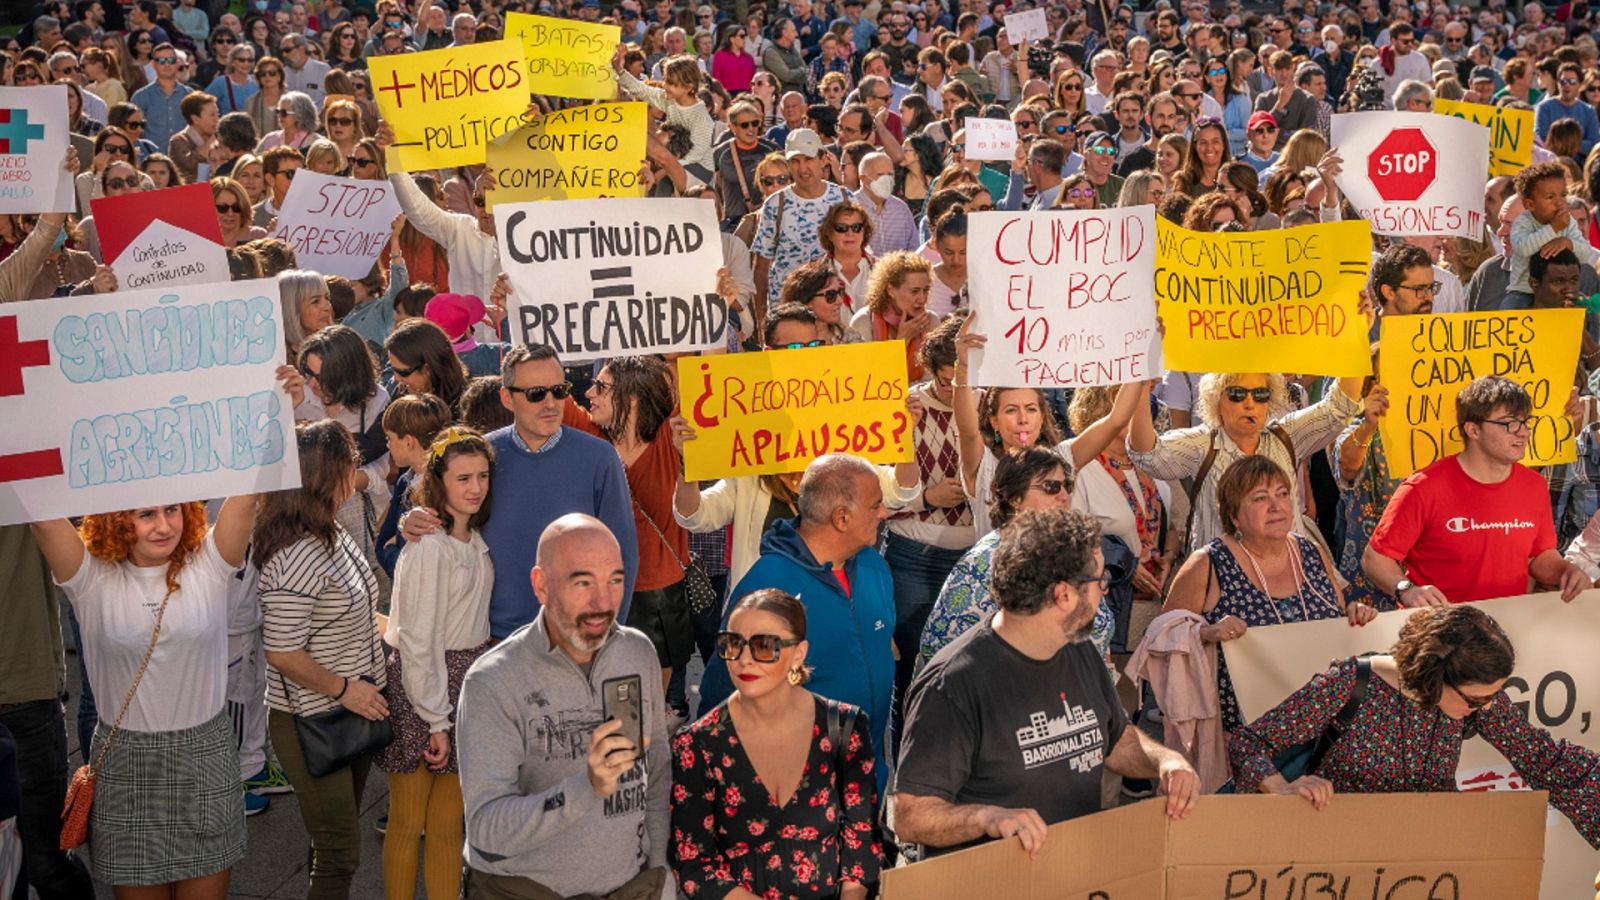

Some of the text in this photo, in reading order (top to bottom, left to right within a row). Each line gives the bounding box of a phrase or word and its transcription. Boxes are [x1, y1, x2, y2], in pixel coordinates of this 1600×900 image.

[420, 58, 522, 103] MÉDICOS
[524, 56, 611, 83] ORBATAS
[527, 133, 619, 151] CONTIGO
[498, 165, 636, 188] COMPAÑERO
[1377, 150, 1430, 176] STOP
[307, 182, 386, 219] STOP
[505, 210, 704, 264] CONTINUIDAD
[994, 215, 1144, 266] CUMPLID
[1156, 229, 1322, 270] VACANTE DE
[1007, 271, 1131, 311] EL BOC
[1154, 268, 1323, 306] CONTINUIDAD
[54, 294, 277, 384] SANCIONES
[519, 291, 728, 353] PRECARIEDAD
[1004, 315, 1050, 355] 10
[1124, 328, 1151, 349] por
[1188, 303, 1346, 341] PRECARIEDAD
[1411, 315, 1535, 353] ¿QUIERES
[1015, 352, 1145, 385] PACIENTE
[1411, 346, 1535, 389] CADA DÍA
[693, 362, 903, 429] ¿RECORDÁIS LOS
[1406, 393, 1442, 426] UN
[69, 390, 285, 489] AGRESIONES
[731, 411, 908, 468] APLAUSOS?
[1445, 517, 1534, 535] Champion
[1022, 727, 1104, 765] BARRIONALISTA
